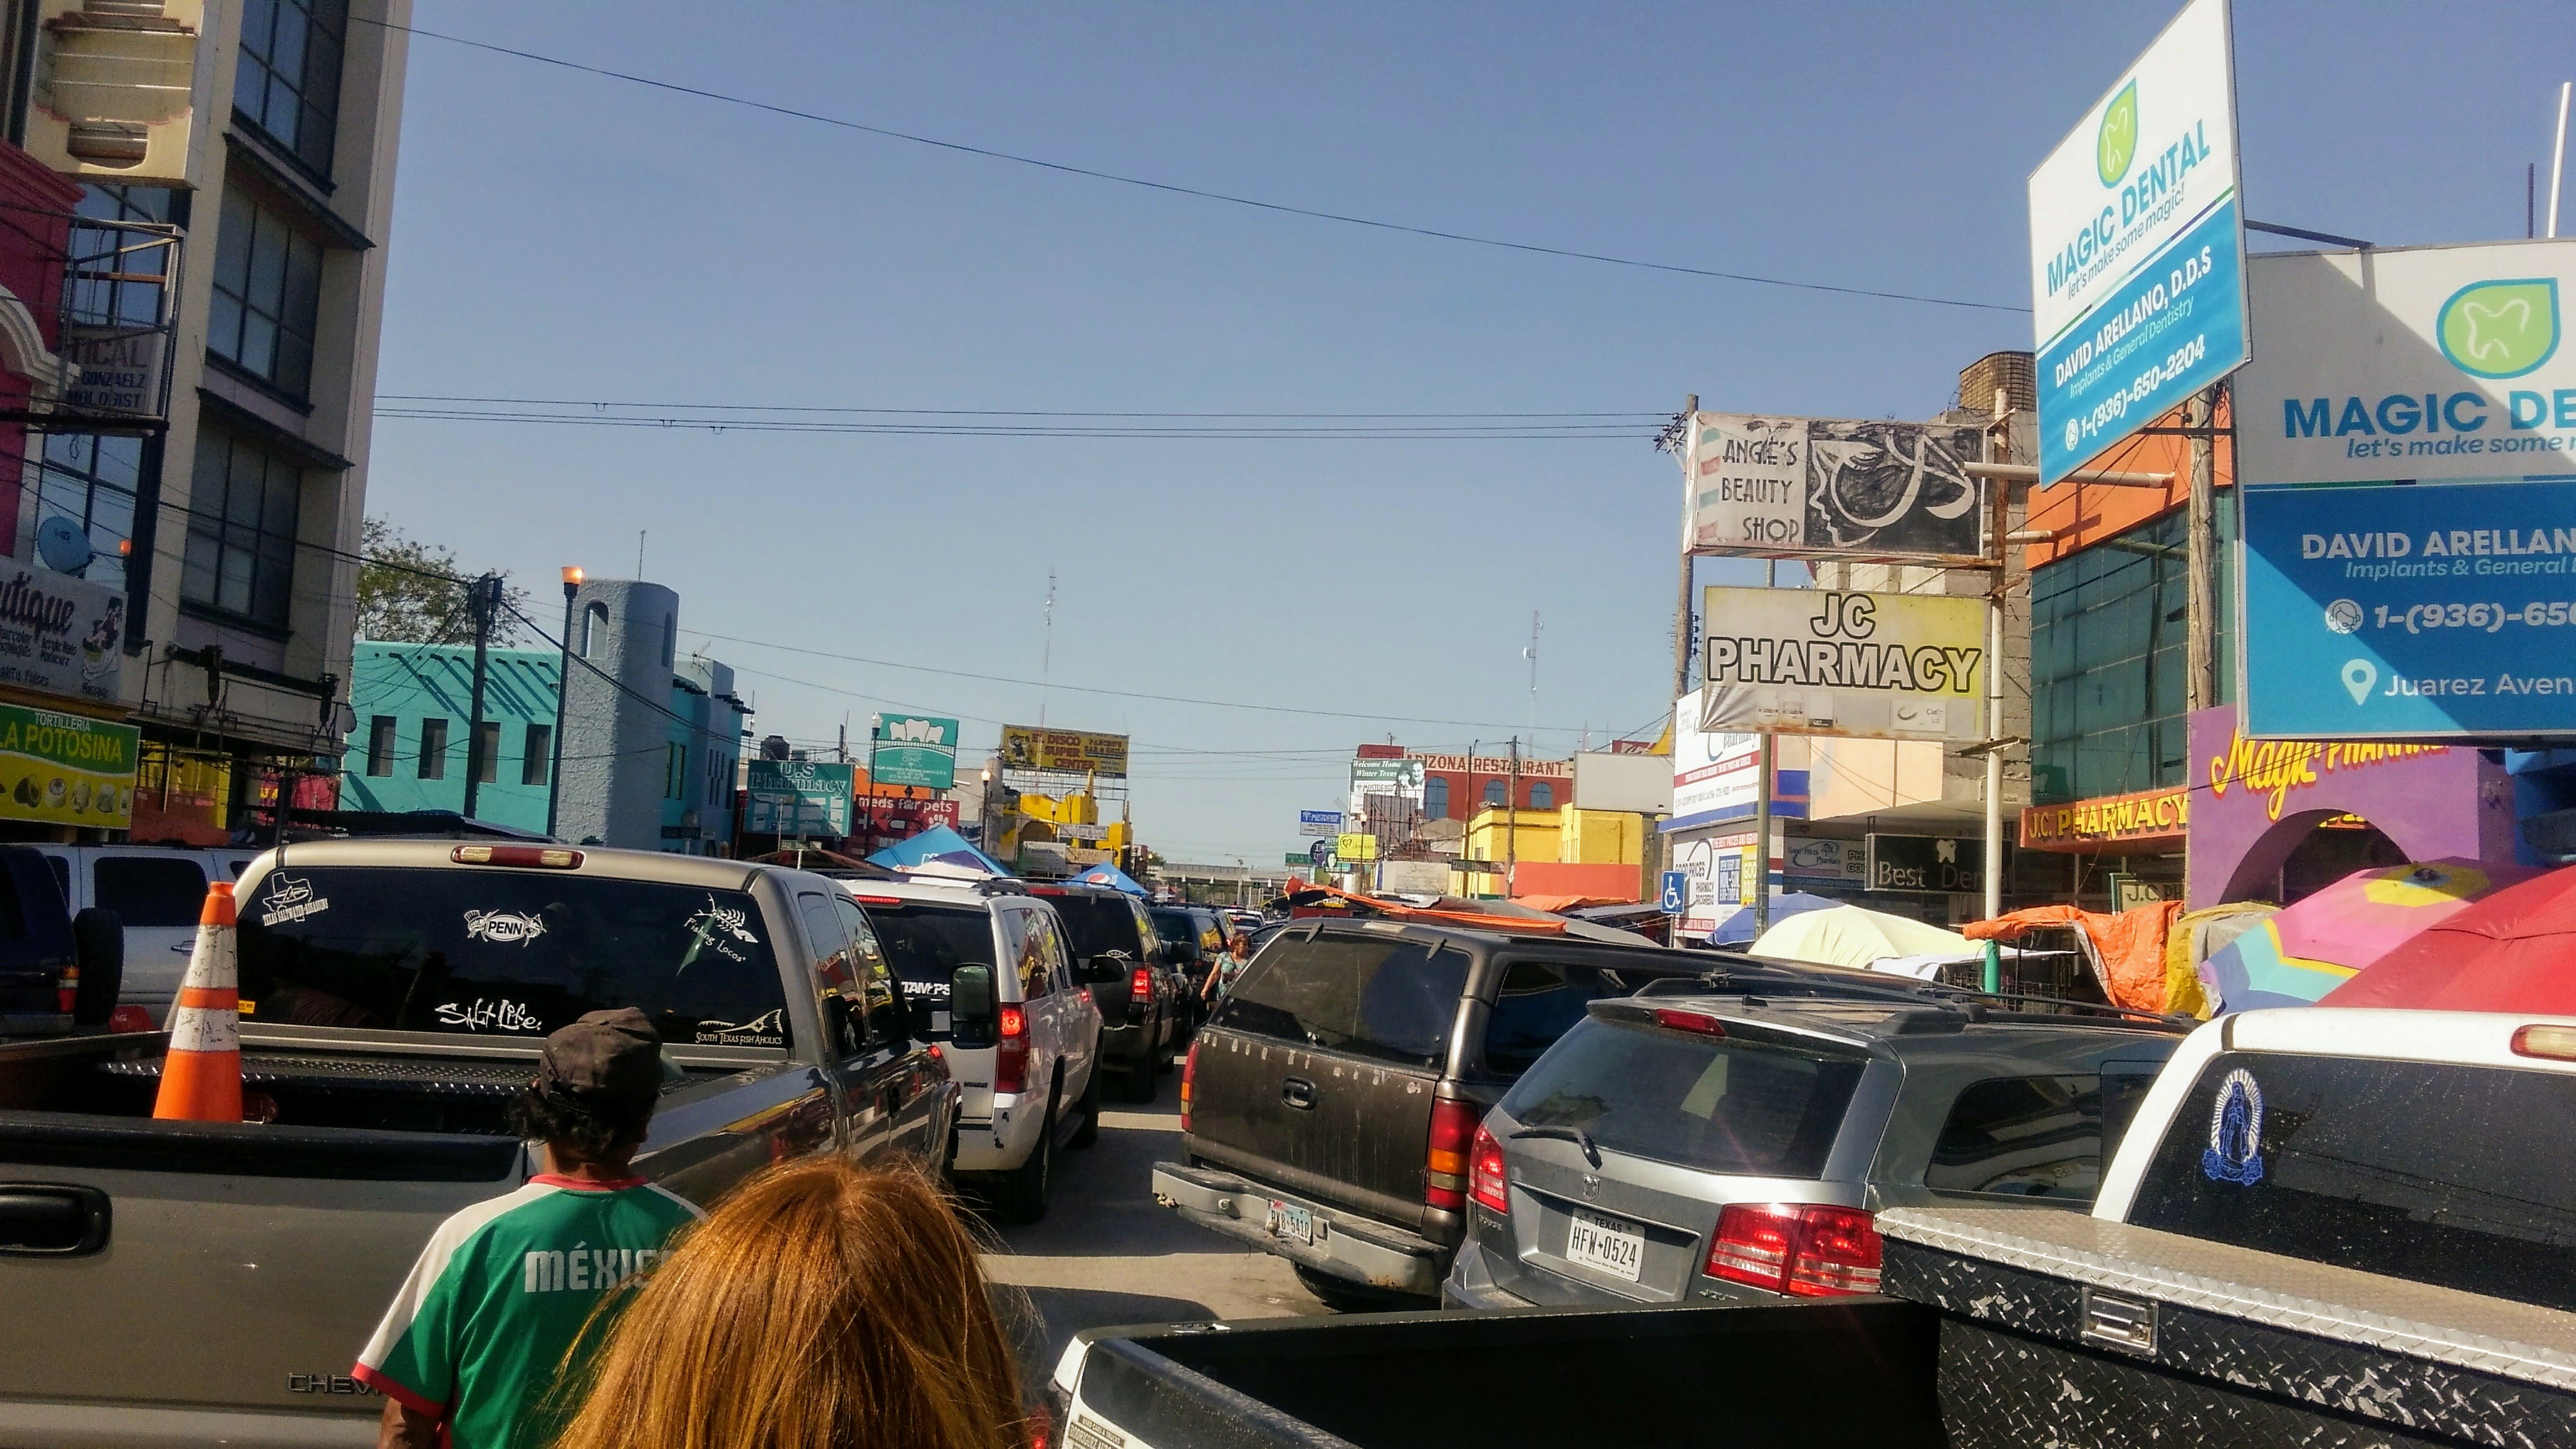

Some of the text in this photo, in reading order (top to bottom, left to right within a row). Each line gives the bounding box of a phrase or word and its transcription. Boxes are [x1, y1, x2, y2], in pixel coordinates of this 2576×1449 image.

[2047, 119, 2211, 297] MAGIC DENTAL
[2068, 181, 2185, 300] let's make some magic!
[2056, 246, 2212, 388] DAVID ARELLANO, D.D.S
[2070, 296, 2193, 398] Implants & General Dentistry
[2081, 334, 2206, 439] 1-(936)-650-2204
[2284, 391, 2487, 438] MAGIC
[1722, 438, 1798, 467] ANGIE'S
[2347, 438, 2403, 459] let's
[2409, 434, 2483, 456] make
[2488, 435, 2563, 453] some
[1721, 477, 1793, 505] BEAUTY
[1743, 516, 1800, 543] SHOP
[2302, 532, 2411, 560] DAVID
[2346, 561, 2448, 581] Implants
[2452, 559, 2469, 575] &
[2475, 557, 2565, 575] General
[1809, 592, 1877, 640] JC
[1707, 636, 1982, 694] PHARMACY
[2384, 675, 2486, 697] Juarez
[35, 712, 91, 733] TORTILLERIA
[25, 724, 123, 764] POTOSINA
[780, 762, 816, 779] U.S
[1353, 760, 1381, 768] Welcome
[750, 772, 848, 797] Pharmacy
[858, 795, 894, 810] meds
[924, 801, 953, 816] pets
[2056, 793, 2188, 840] PHARMACY
[1878, 861, 1926, 888] Best
[487, 921, 523, 935] PENN
[684, 917, 716, 946] Fishing
[1594, 1217, 1622, 1233] TEXAS
[524, 1241, 671, 1292] MÉXIC
[288, 1372, 381, 1396] CHEV
